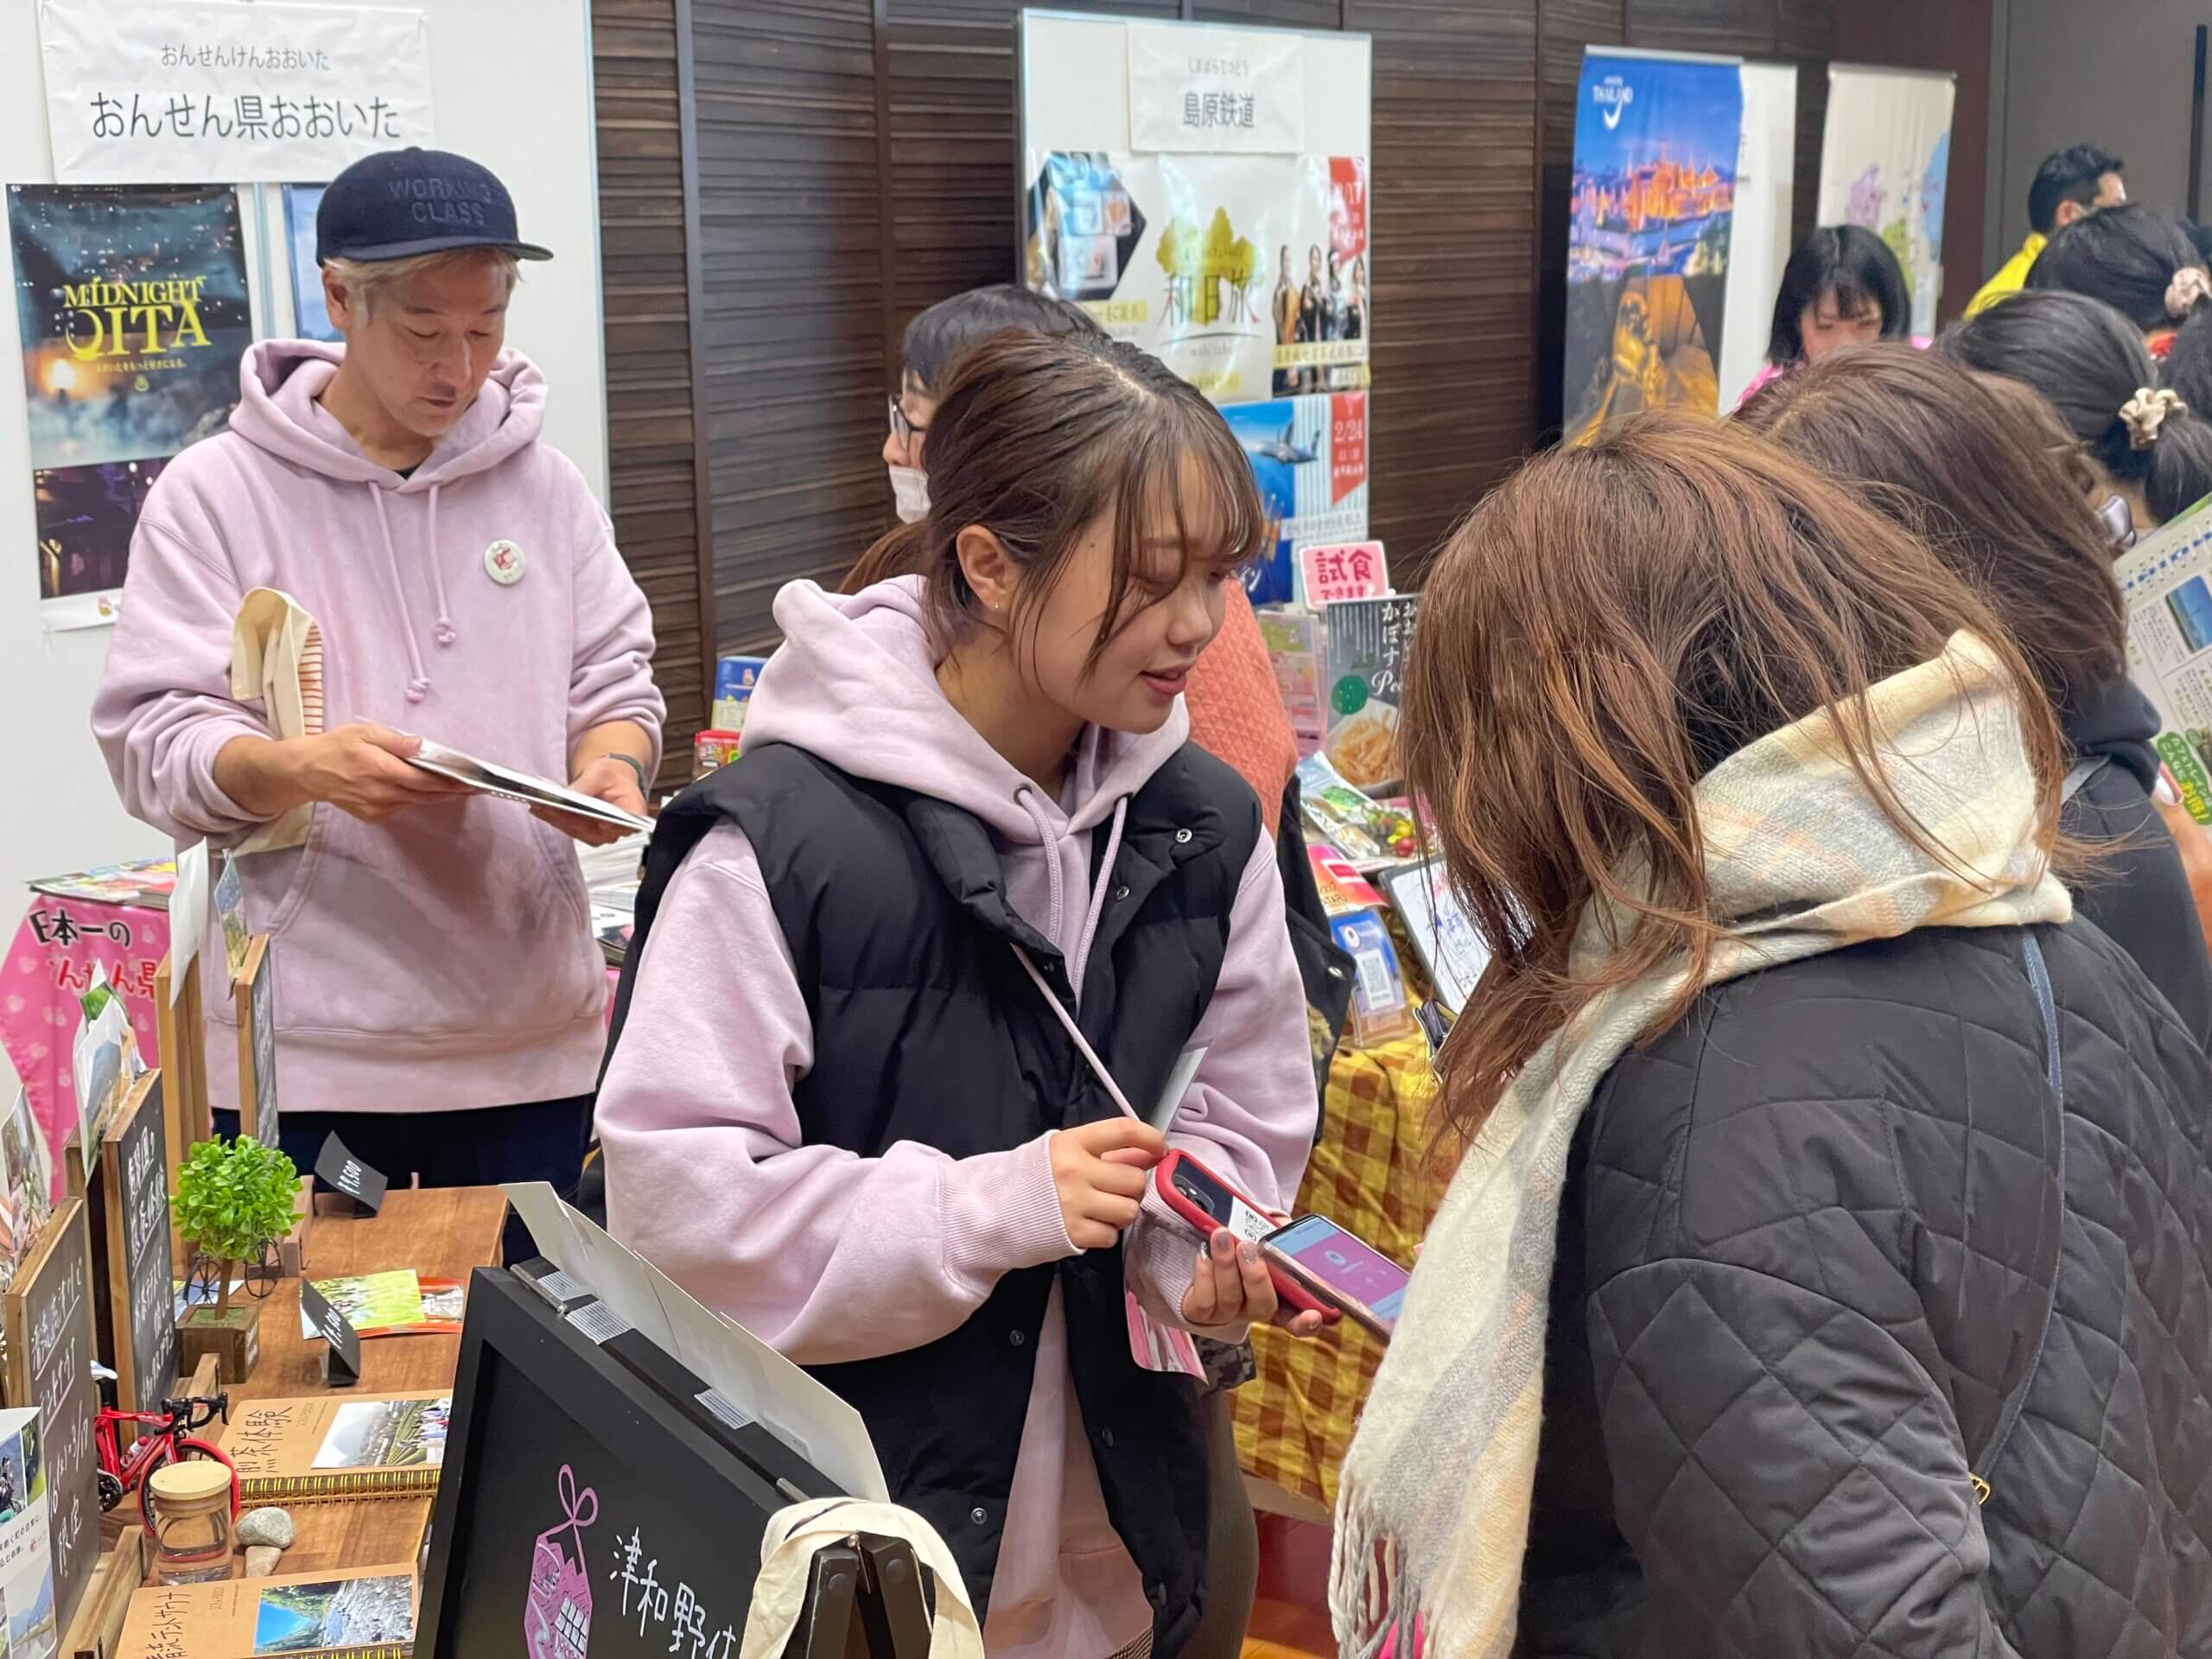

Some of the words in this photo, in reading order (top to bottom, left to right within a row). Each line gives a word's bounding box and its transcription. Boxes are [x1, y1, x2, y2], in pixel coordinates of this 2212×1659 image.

[160, 43, 330, 70] おんせんけんおおいた
[90, 92, 401, 139] おんせん県おおいた
[1183, 91, 1255, 128] 島原鉄道
[411, 200, 485, 226] CLASS
[1315, 549, 1372, 585] 試食
[1382, 602, 1401, 668] かぼす
[29, 910, 130, 948] 日本一の
[48, 957, 156, 1000] んん県
